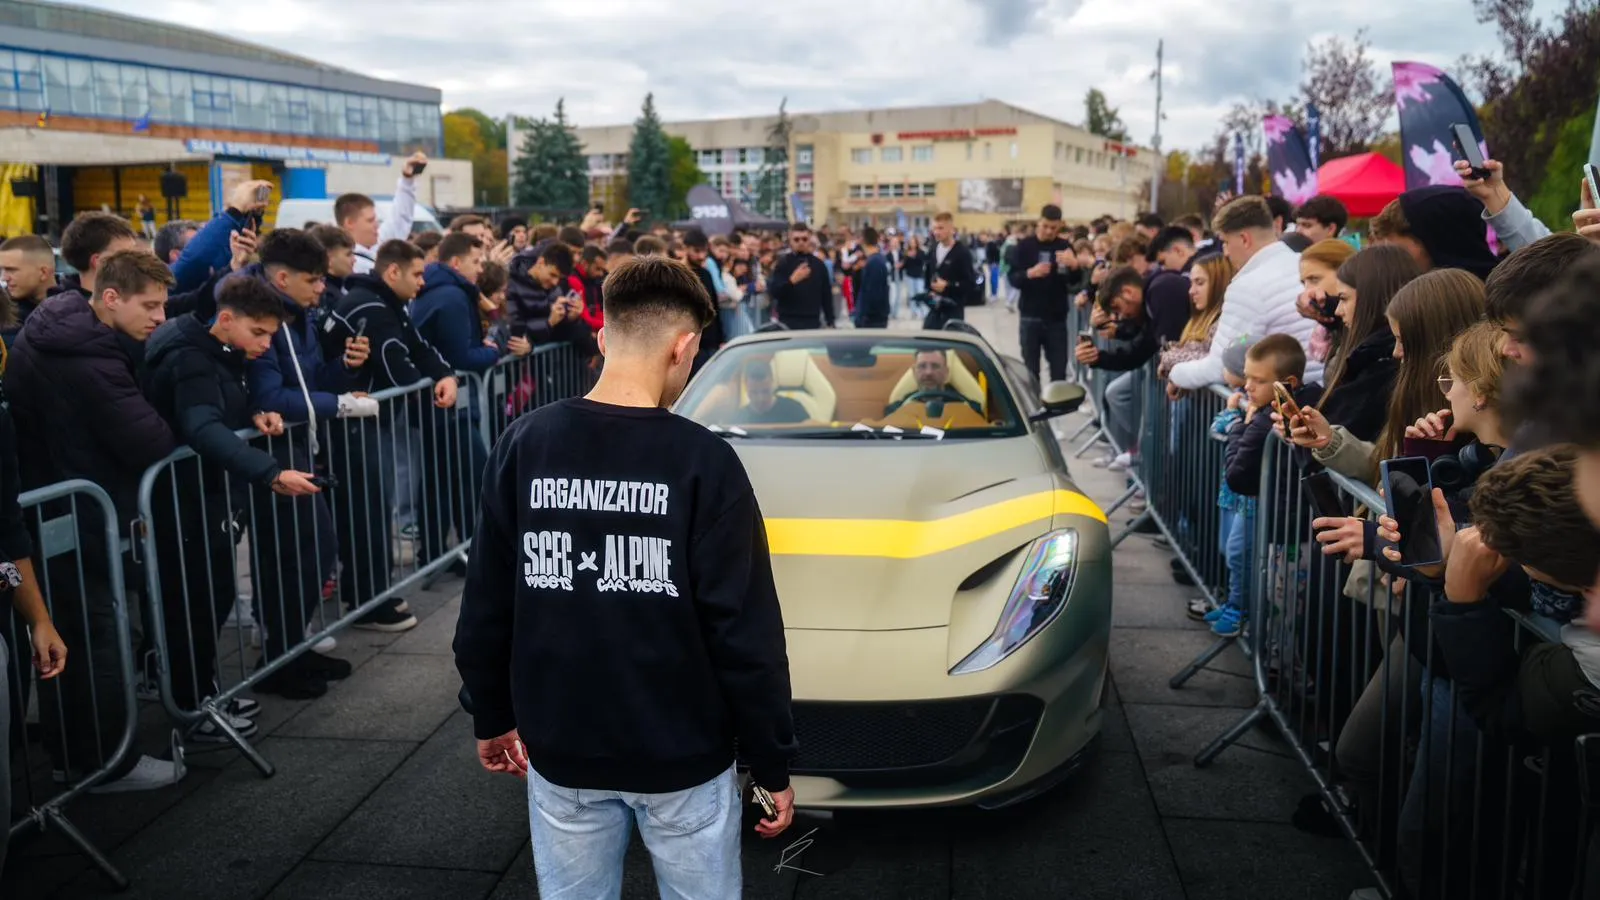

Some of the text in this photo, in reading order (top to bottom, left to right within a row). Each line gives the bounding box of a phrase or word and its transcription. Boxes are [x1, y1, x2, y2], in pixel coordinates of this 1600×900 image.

[530, 478, 669, 515] ORGANIZATOR
[523, 531, 573, 580] SCFC
[604, 534, 672, 583] ALPINE
[597, 577, 628, 592] CAR
